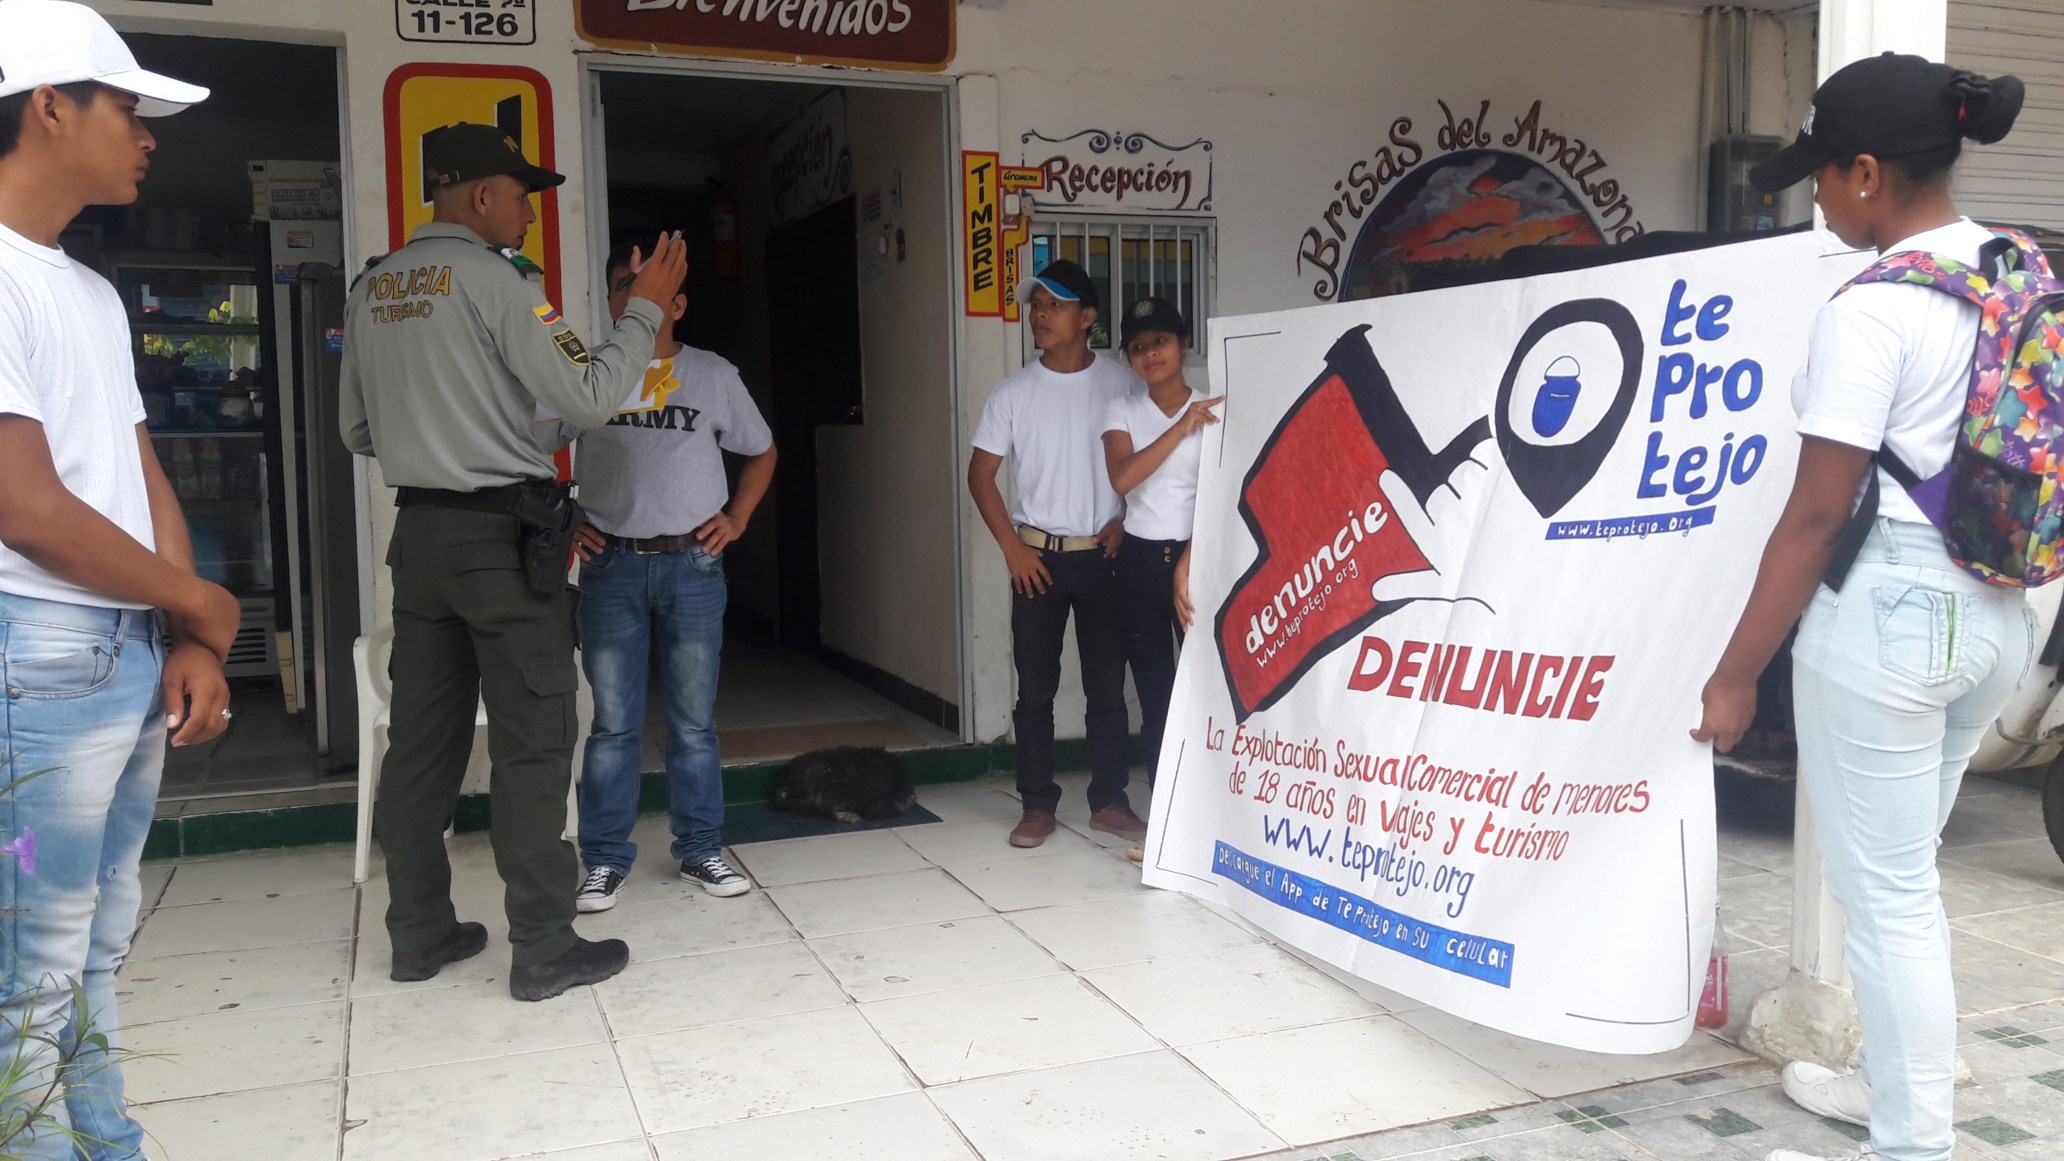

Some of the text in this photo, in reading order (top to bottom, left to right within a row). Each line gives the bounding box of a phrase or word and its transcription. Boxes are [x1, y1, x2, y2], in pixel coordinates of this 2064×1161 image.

[411, 10, 518, 36] 11-126
[1437, 99, 1491, 151] del
[1041, 155, 1192, 209] Recepción
[970, 162, 993, 291] TIMBRE
[366, 266, 451, 302] POLICIA
[371, 300, 433, 323] TURSMO
[1006, 248, 1014, 305] BRISAS
[1660, 279, 1733, 346] te
[1637, 431, 1768, 506] tejo
[1245, 502, 1388, 653] denuncie
[1347, 636, 1615, 721] DENUNCIE
[1206, 716, 1225, 751] La
[1231, 724, 1327, 773] Explotación
[1520, 771, 1551, 815] de
[1552, 779, 1650, 816] menores
[1229, 761, 1247, 795] de
[1253, 769, 1281, 804] 18
[1286, 781, 1335, 820] años
[1346, 794, 1367, 826] en
[1443, 817, 1465, 856] y
[1265, 867, 1276, 888] el
[1281, 873, 1303, 904] App
[1312, 888, 1329, 910] de
[1396, 923, 1409, 941] en
